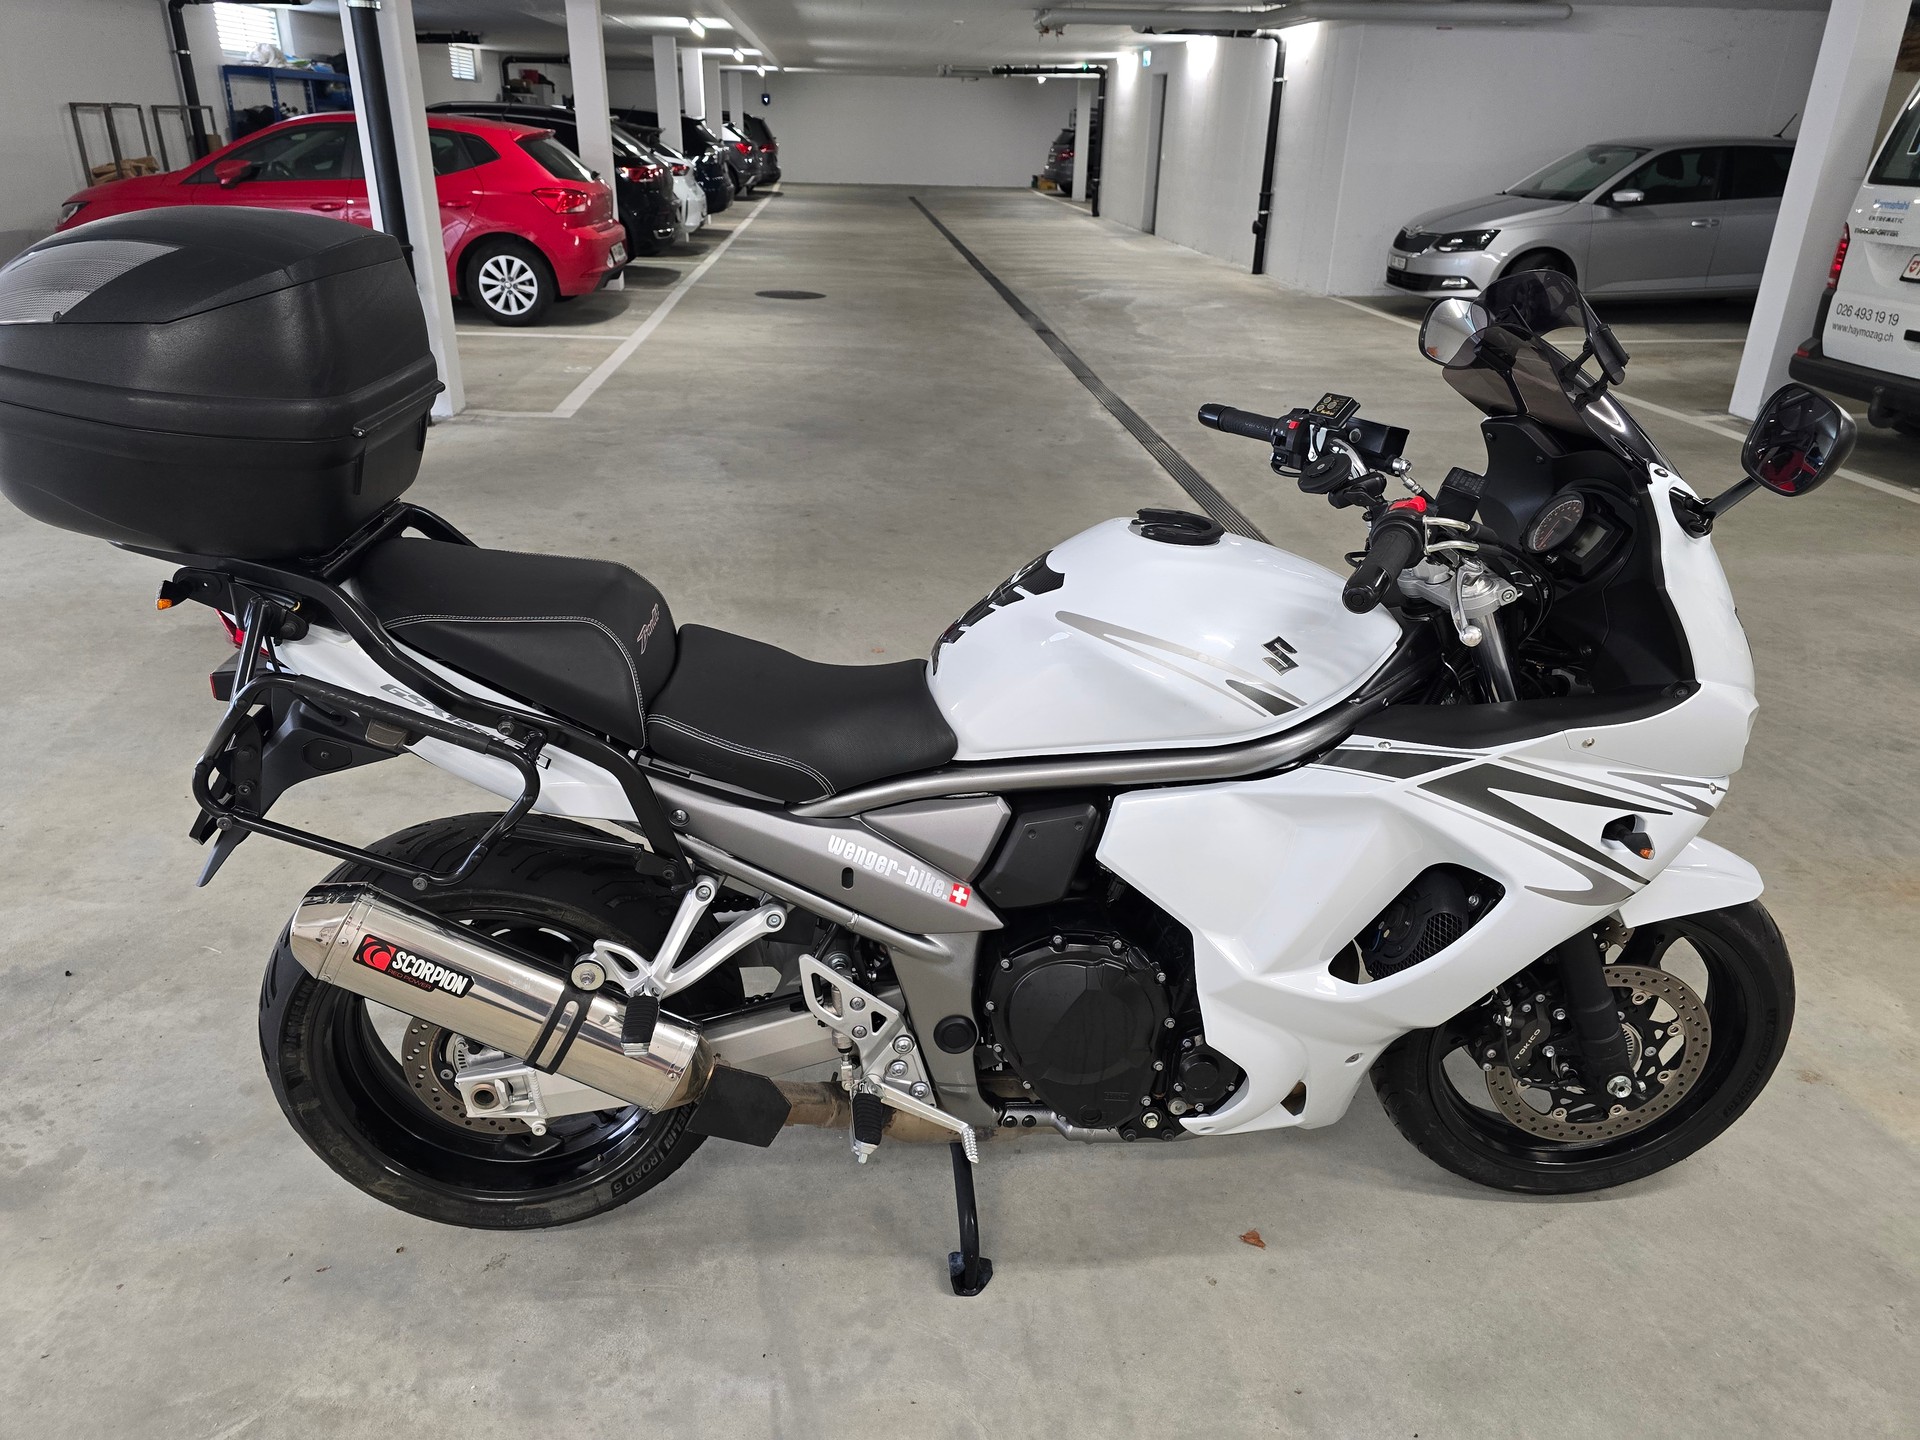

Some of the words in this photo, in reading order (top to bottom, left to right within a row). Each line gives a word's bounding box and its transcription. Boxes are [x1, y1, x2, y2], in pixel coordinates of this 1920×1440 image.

[1836, 303, 1854, 317] 026
[1854, 307, 1873, 321] 493
[1875, 311, 1886, 324] 19
[1888, 313, 1900, 326] 19
[1832, 323, 1894, 342] www.haymozag.ch
[387, 968, 403, 980] RED
[403, 974, 432, 990] POWER
[391, 951, 469, 995] SCORPION
[1514, 1028, 1541, 1060] TOKICO
[625, 1154, 659, 1186] ROAD
[613, 1182, 623, 1194] 5
